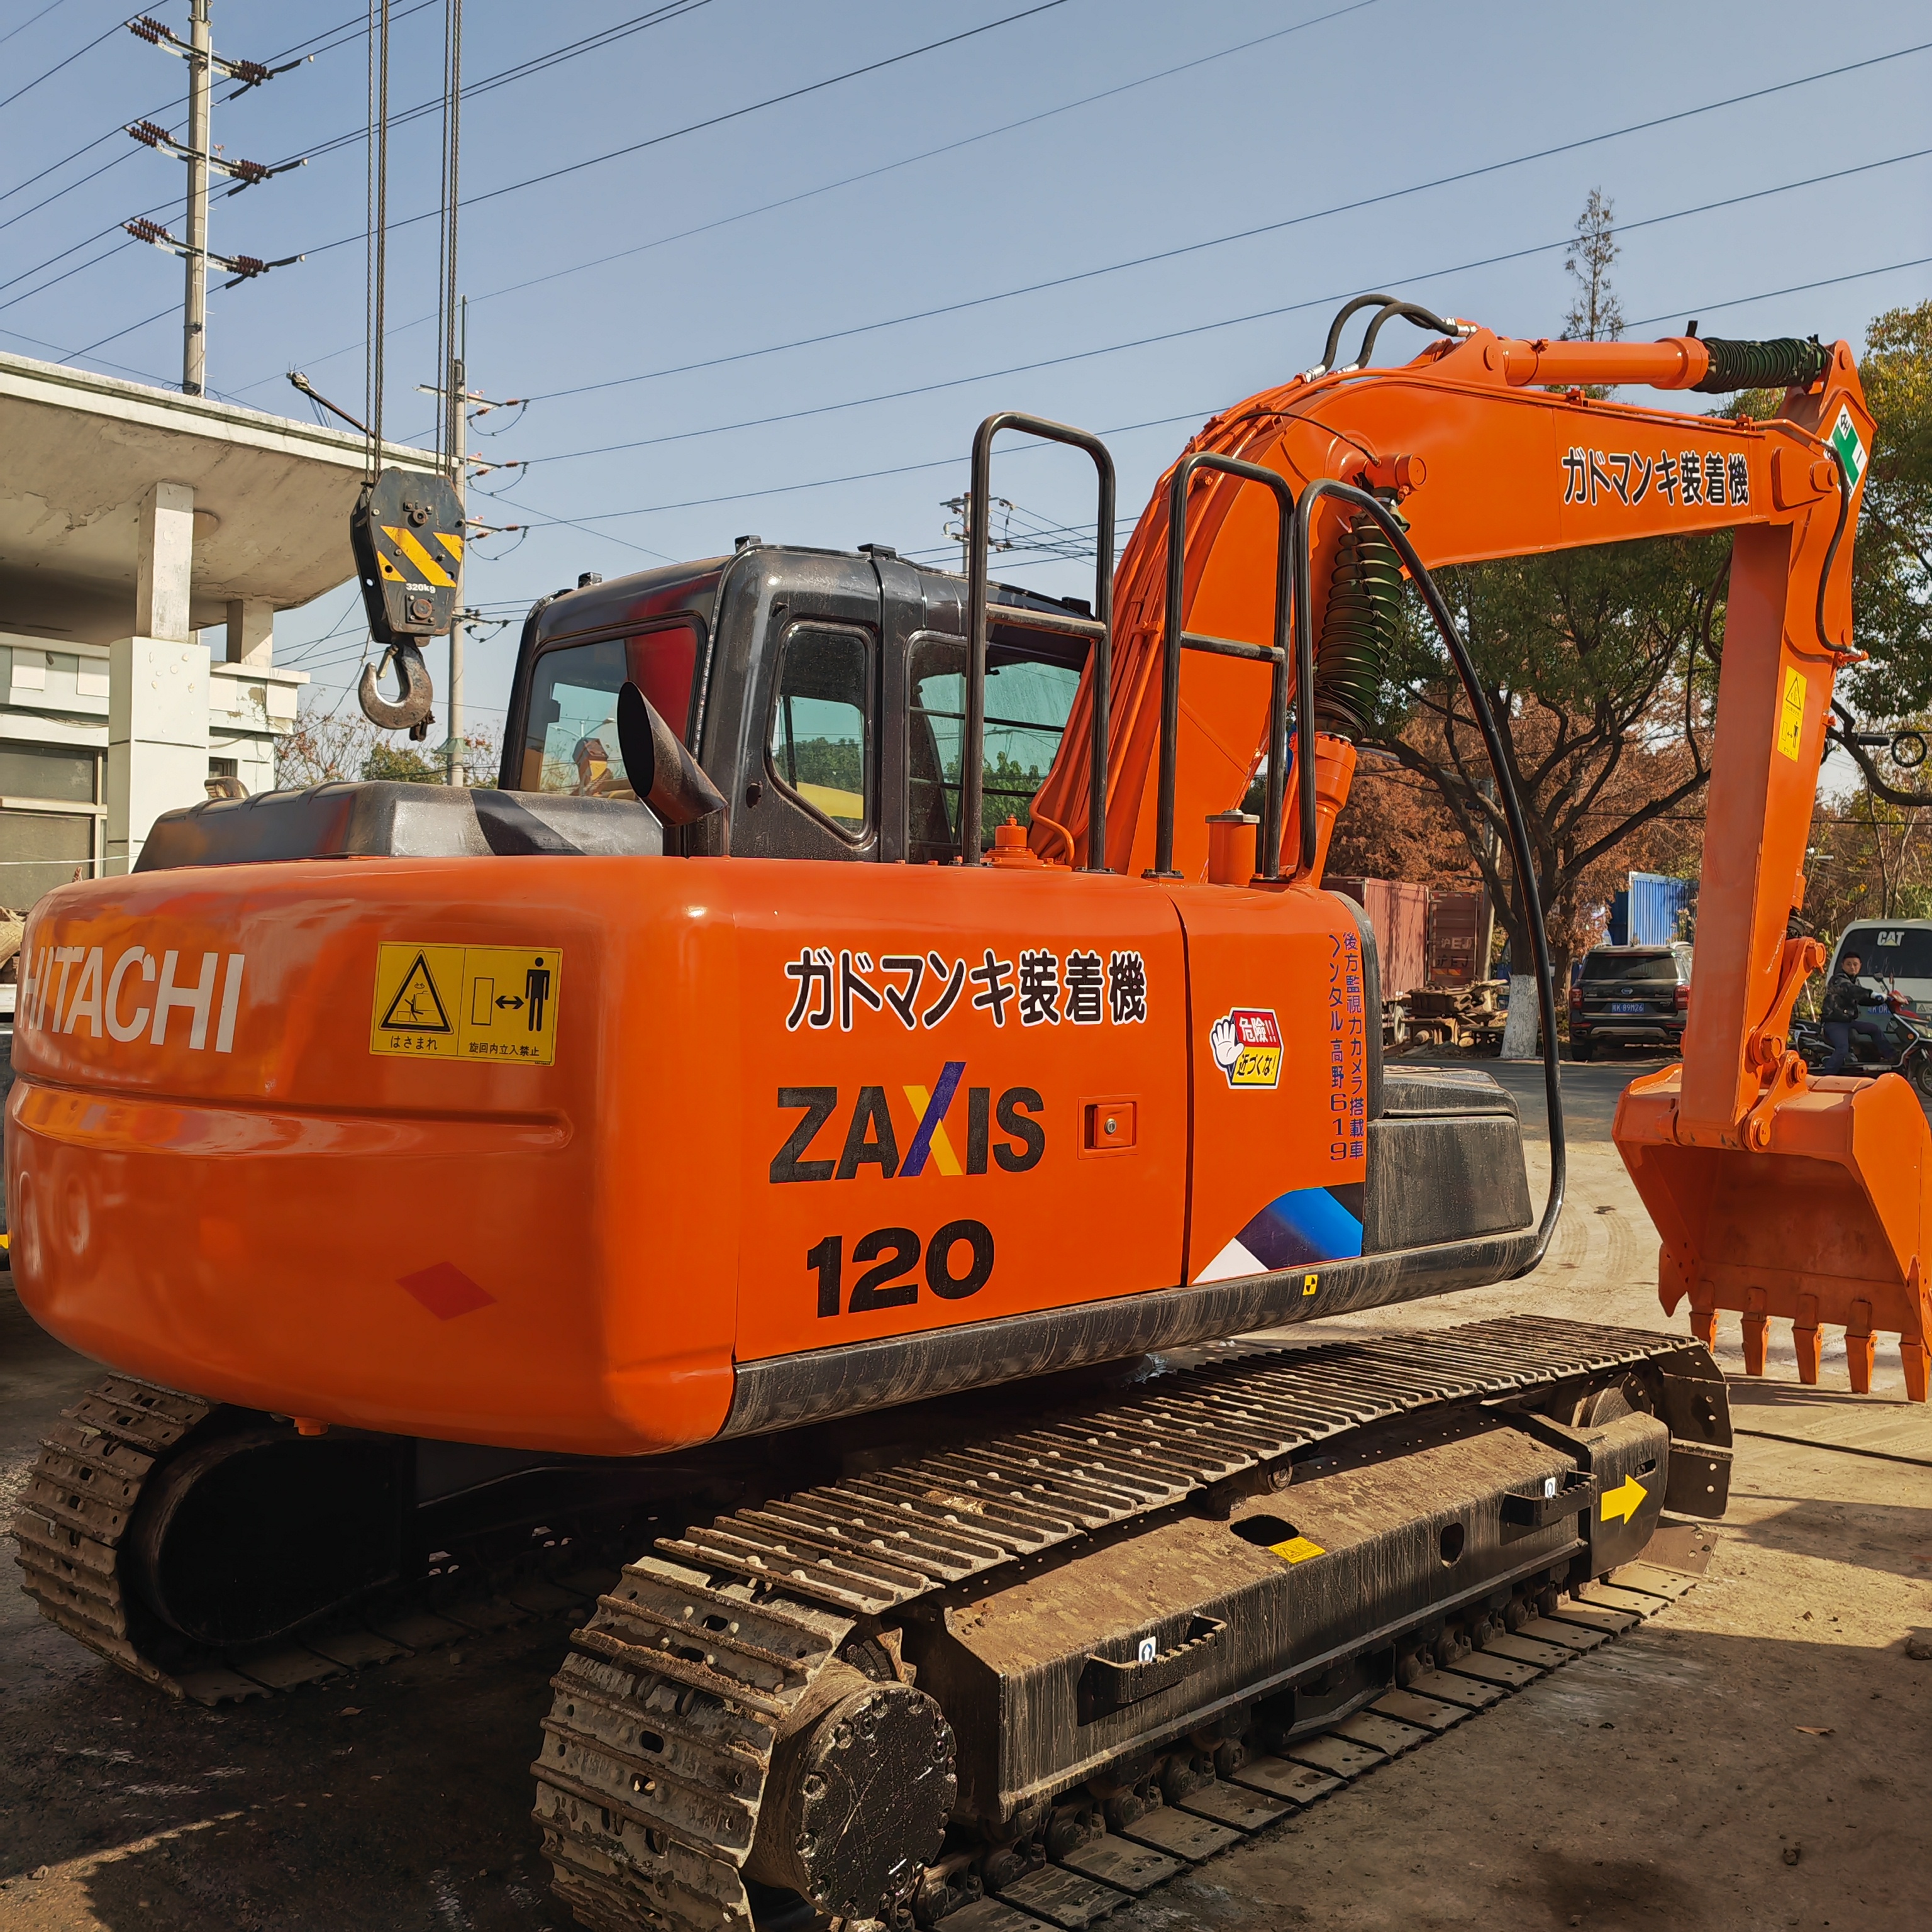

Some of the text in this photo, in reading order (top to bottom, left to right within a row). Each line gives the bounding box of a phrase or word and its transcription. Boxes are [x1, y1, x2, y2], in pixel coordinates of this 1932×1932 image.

[1562, 447, 1749, 506] ガドマンキ装着機
[406, 583, 436, 594] 320kg
[1877, 931, 1904, 947] CAT
[19, 946, 245, 1053] HITACHI
[784, 947, 1147, 1032] ガドマンキ装着機
[391, 1035, 438, 1050] はさまれ
[469, 1041, 540, 1057] 旋回内立入禁止
[769, 1061, 1046, 1183] ZAXIS
[807, 1219, 995, 1319] 120
